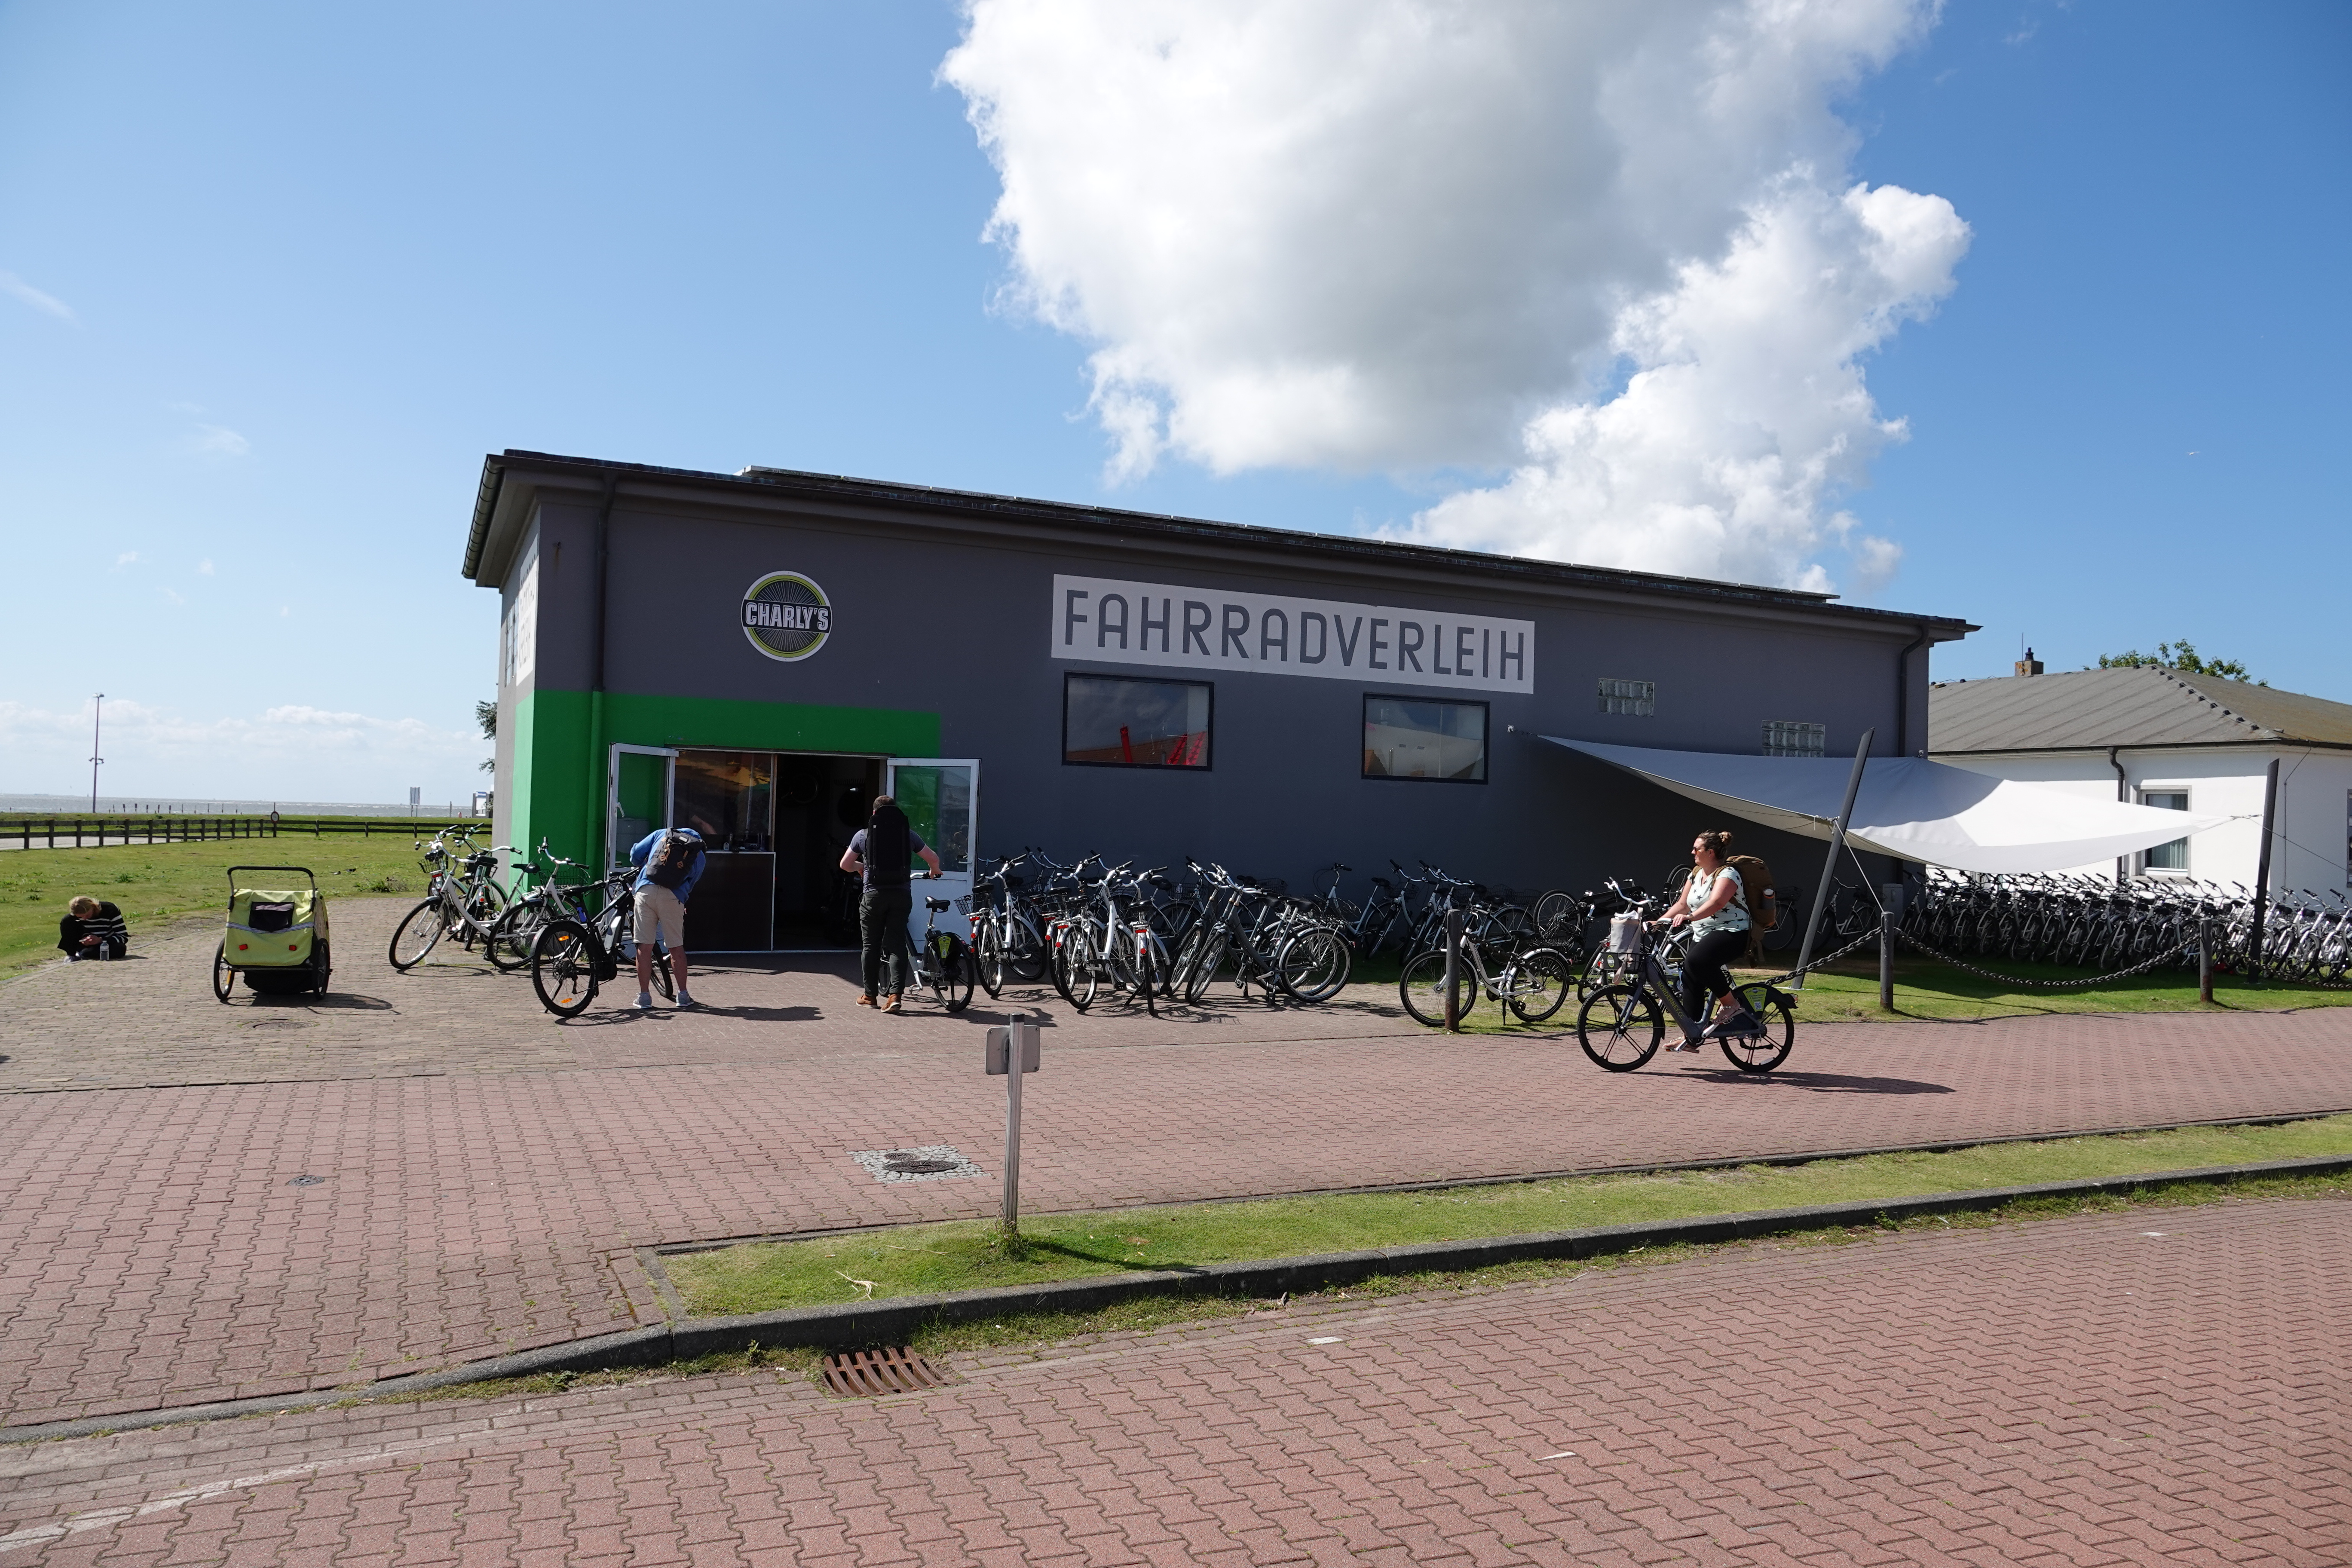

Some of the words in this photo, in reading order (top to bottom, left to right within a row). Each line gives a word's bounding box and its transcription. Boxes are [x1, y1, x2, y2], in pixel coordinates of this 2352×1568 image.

[745, 602, 829, 631] CHARLY'S
[1065, 589, 1525, 680] FAHRRADVERLEIH
[1657, 981, 1685, 1019] NORDERNEY.CC
